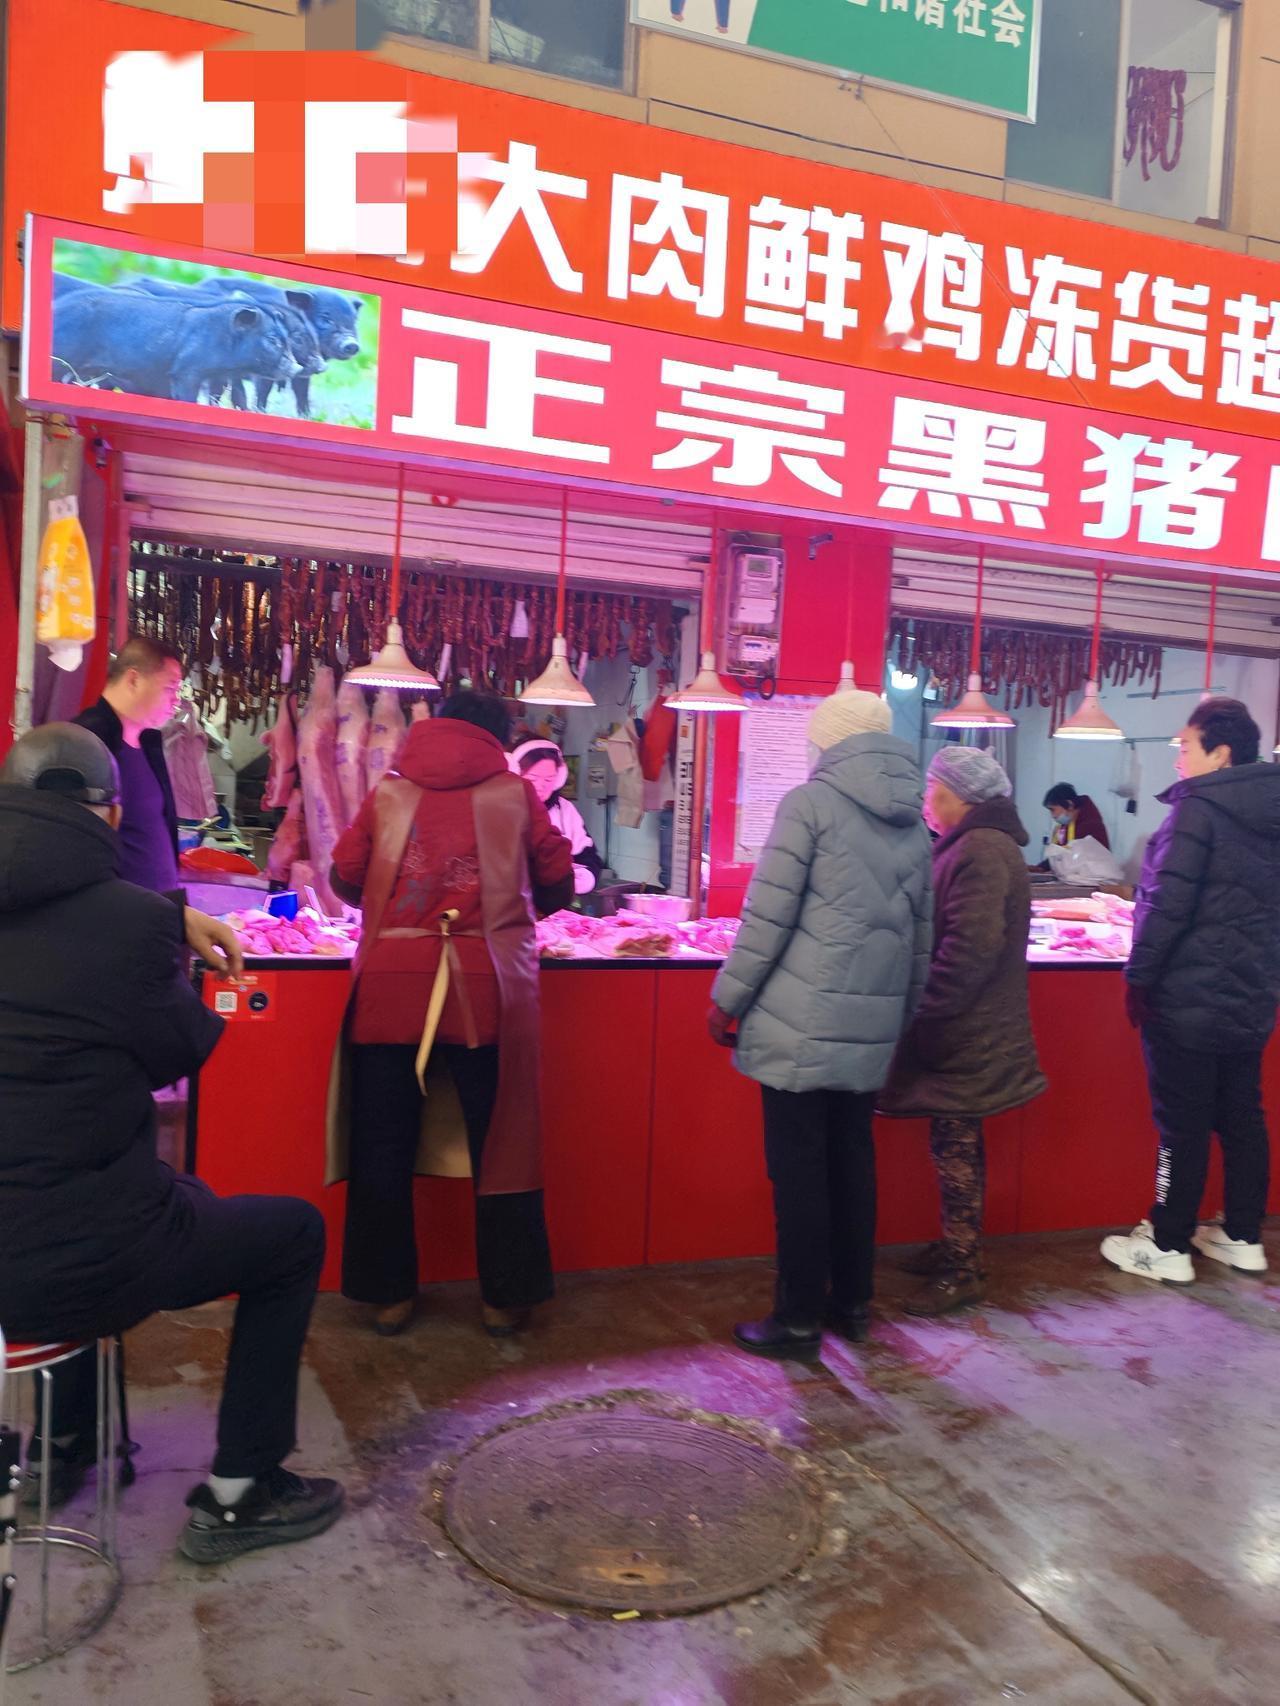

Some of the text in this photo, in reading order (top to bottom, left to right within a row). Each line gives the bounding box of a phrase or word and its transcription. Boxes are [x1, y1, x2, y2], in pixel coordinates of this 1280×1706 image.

[846, 0, 1026, 48] 谐社会
[391, 308, 1280, 561] 正宗黑猪
